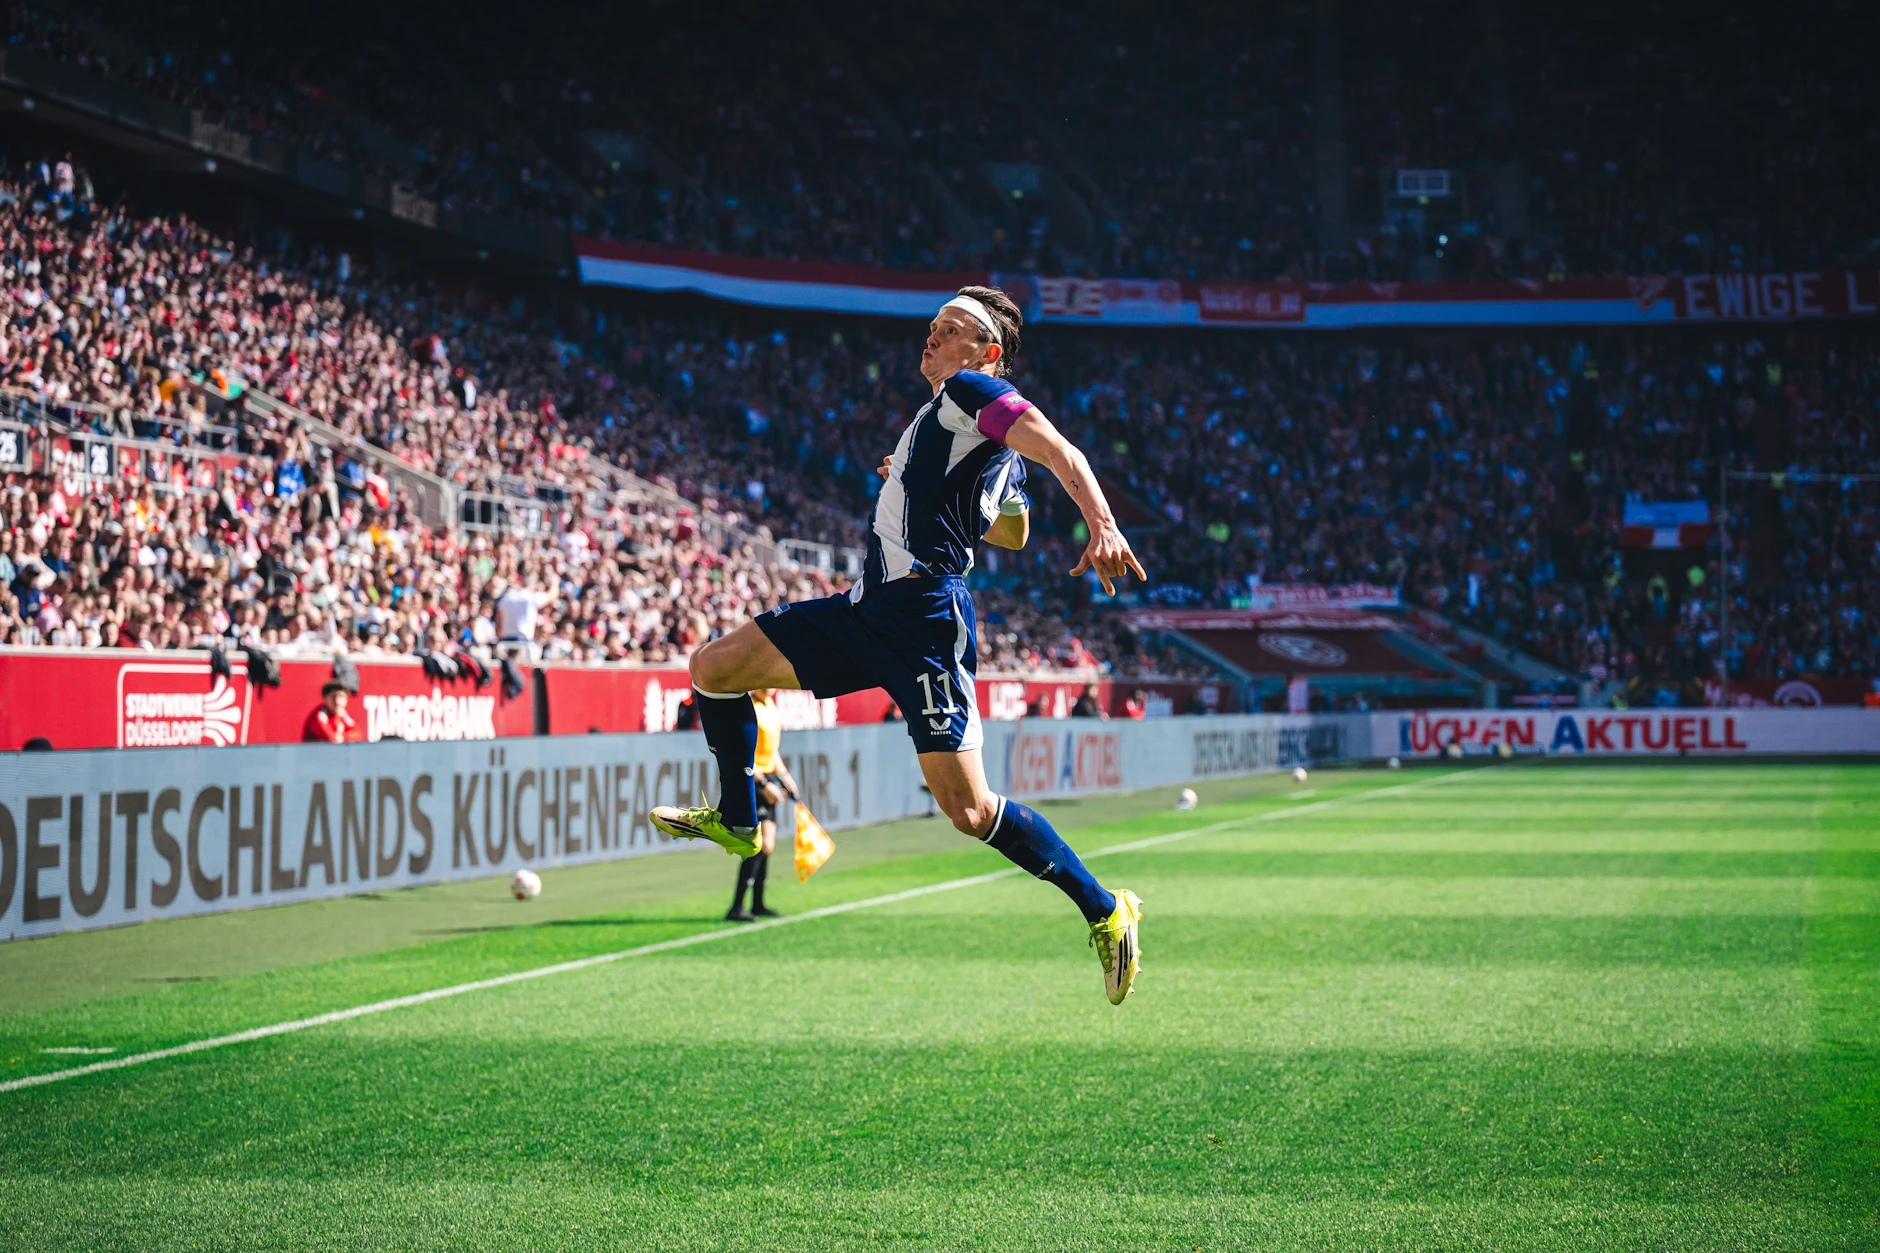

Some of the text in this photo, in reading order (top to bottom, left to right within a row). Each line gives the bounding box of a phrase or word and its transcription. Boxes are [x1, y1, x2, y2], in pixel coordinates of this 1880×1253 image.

[1684, 270, 1880, 318] EWIGE L
[125, 693, 204, 718] STADTWERKE
[917, 672, 960, 715] 11
[125, 719, 203, 746] DÜSSELDORF
[1551, 715, 1747, 752] AKTUELL
[849, 748, 860, 819] 1
